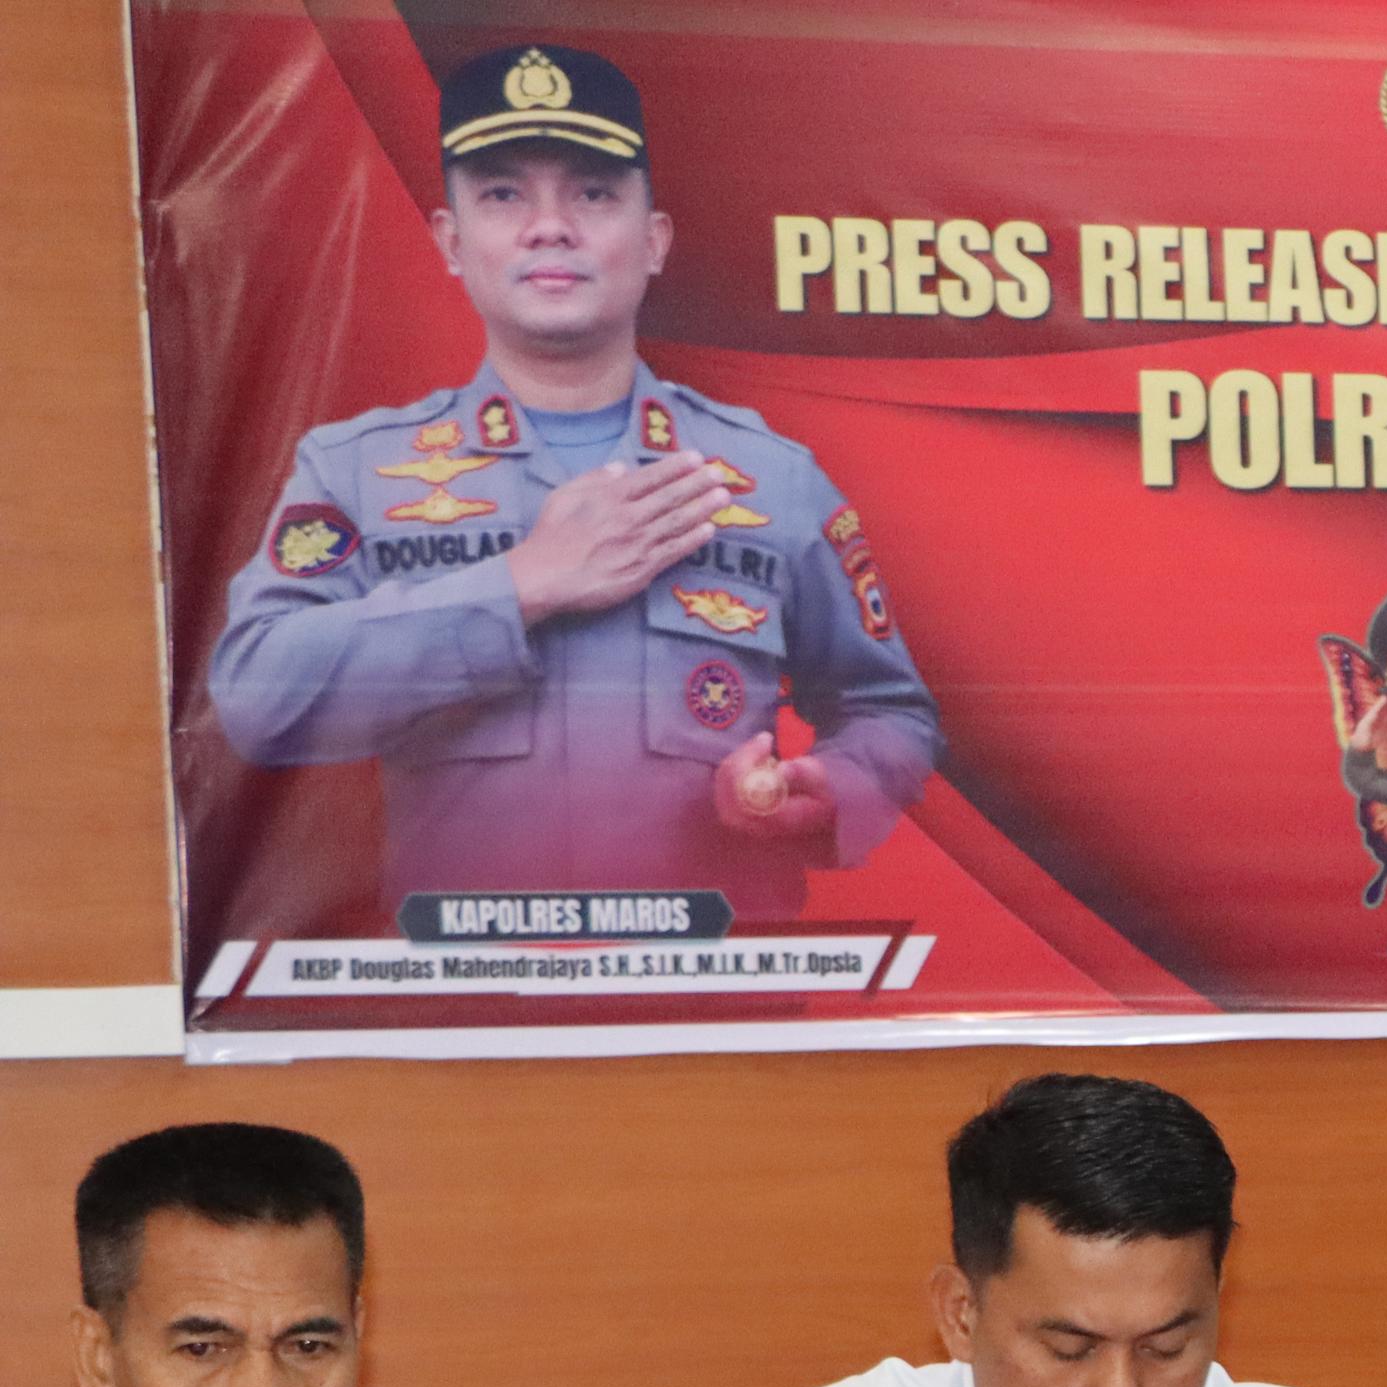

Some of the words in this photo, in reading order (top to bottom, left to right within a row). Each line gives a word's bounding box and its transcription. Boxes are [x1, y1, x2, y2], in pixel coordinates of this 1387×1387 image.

[774, 215, 1051, 320] PRESS
[440, 898, 582, 935] KAPOLRES
[589, 897, 691, 933] MAROS
[292, 958, 342, 981] AKBP
[350, 956, 434, 982] Douglas
[442, 954, 593, 981] Mahendrajaya
